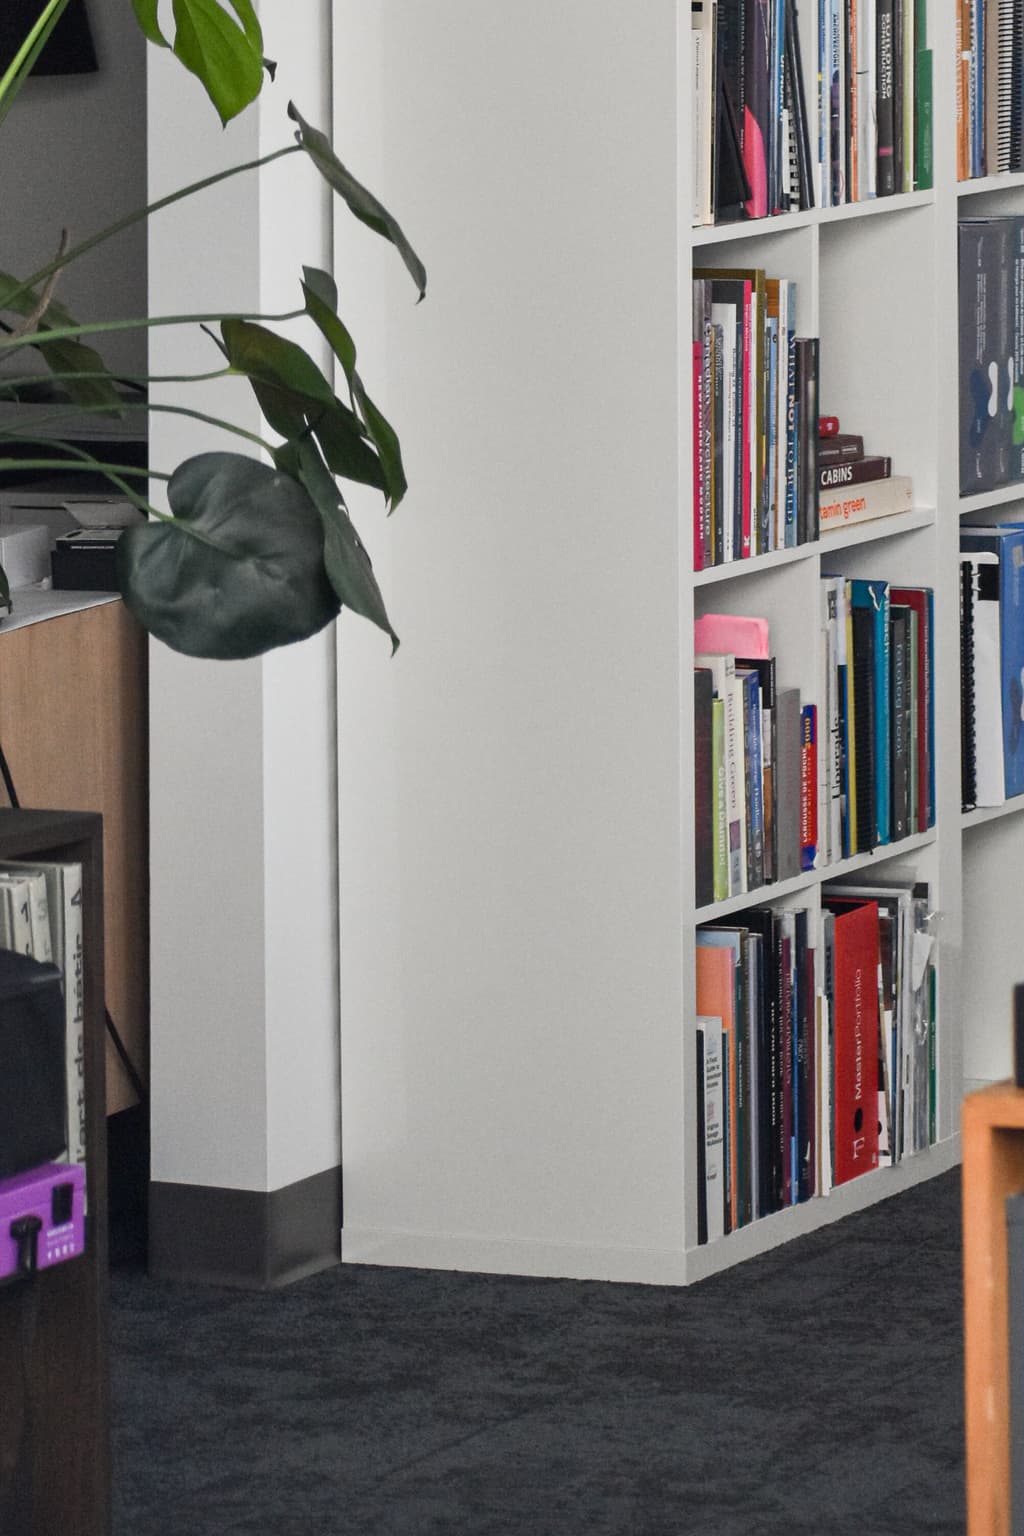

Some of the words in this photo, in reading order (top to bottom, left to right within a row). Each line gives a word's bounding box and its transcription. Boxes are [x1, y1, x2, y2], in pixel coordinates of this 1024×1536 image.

[704, 321, 712, 405] Canadian
[788, 334, 796, 389] WHAT
[787, 440, 794, 464] TO
[821, 465, 853, 485] CABINS
[787, 468, 795, 524] BUILD
[843, 498, 866, 520] green
[727, 692, 736, 759] Building
[74, 1035, 84, 1077] de
[854, 968, 863, 1100] MasterPortfolio
